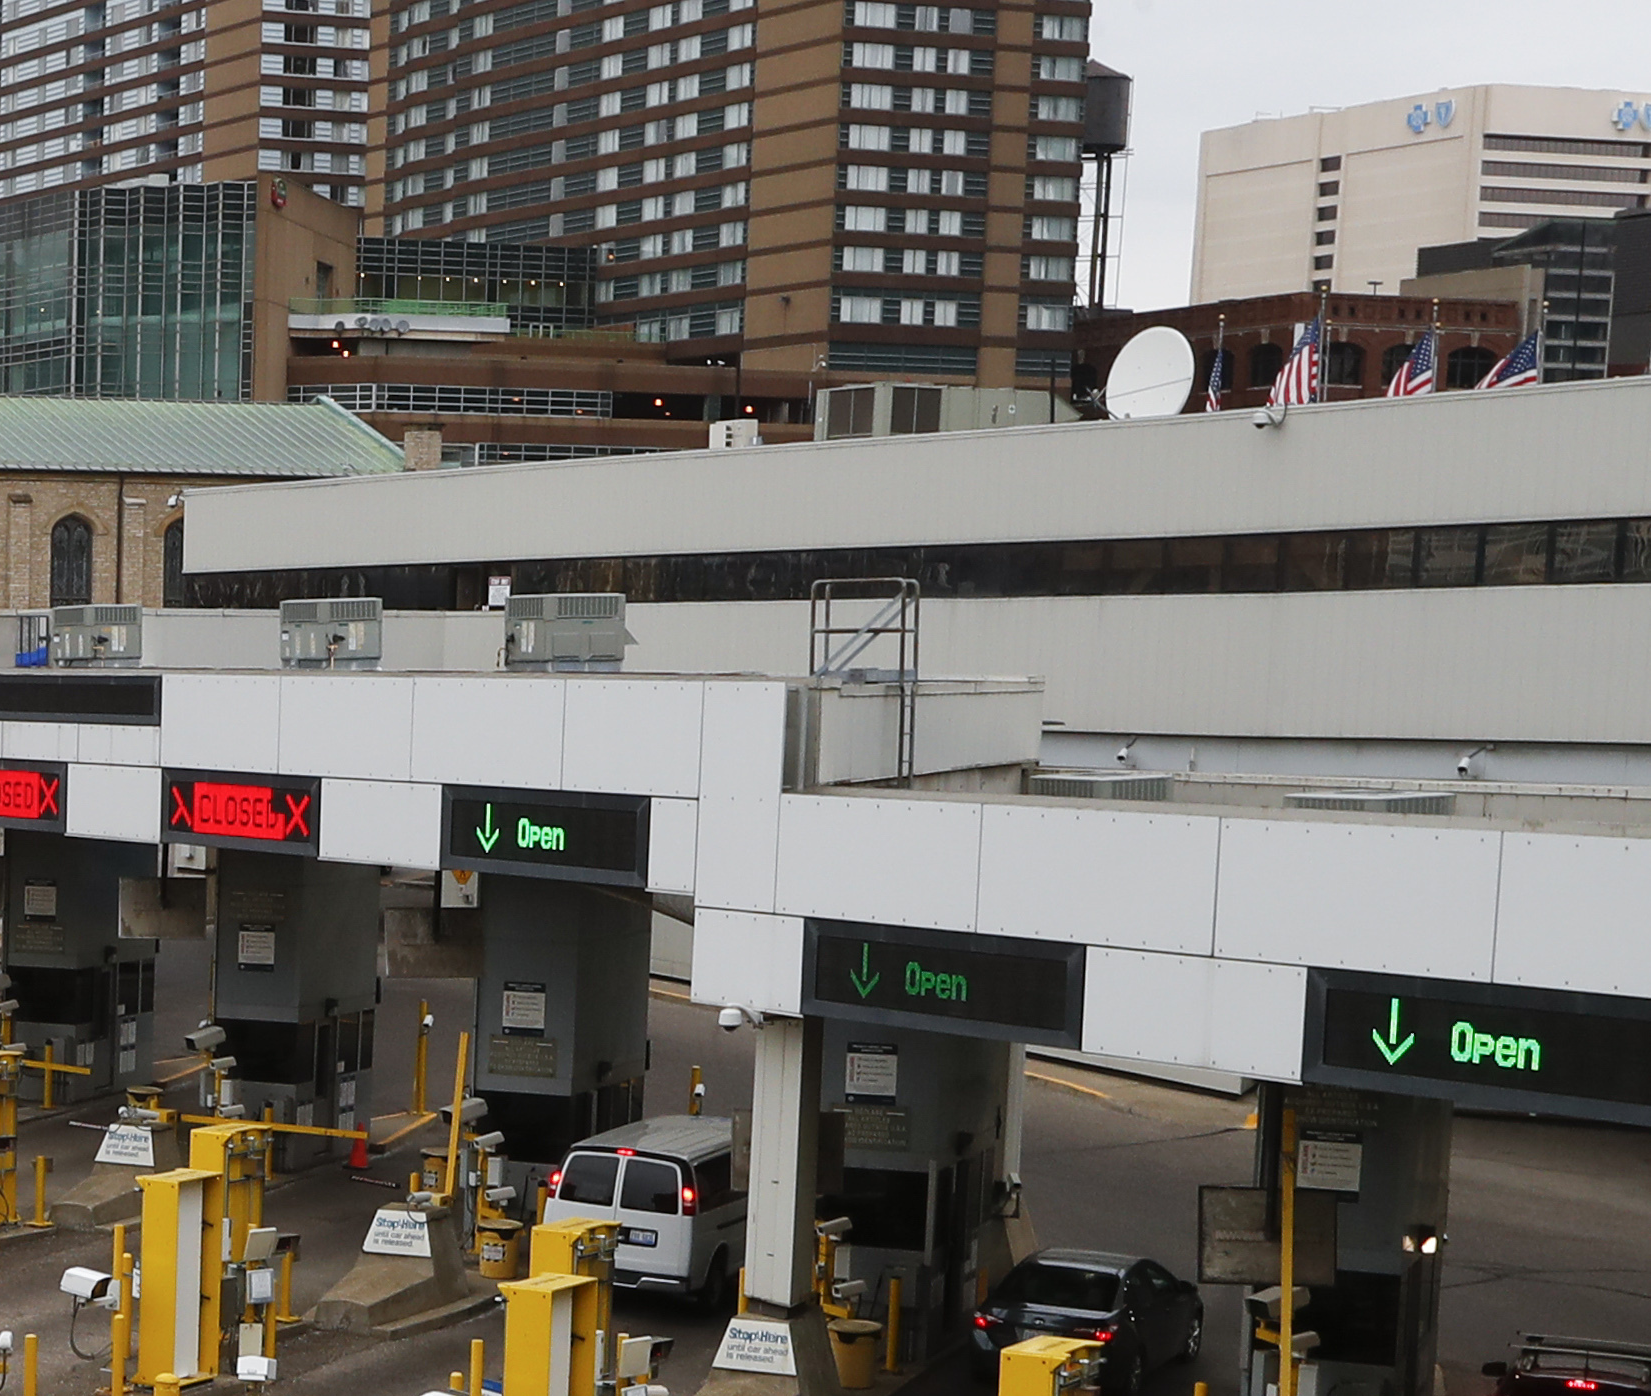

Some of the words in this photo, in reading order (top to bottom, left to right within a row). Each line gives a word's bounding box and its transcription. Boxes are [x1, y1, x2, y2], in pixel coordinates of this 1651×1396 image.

[517, 816, 565, 851] Open
[905, 961, 967, 1002] Open
[1450, 1020, 1541, 1072] Open
[375, 1230, 389, 1238] until
[403, 1232, 425, 1242] ahead
[729, 1327, 757, 1343] Stop
[727, 1343, 745, 1352] until
[747, 1345, 762, 1353] car
[763, 1346, 789, 1356] ahead
